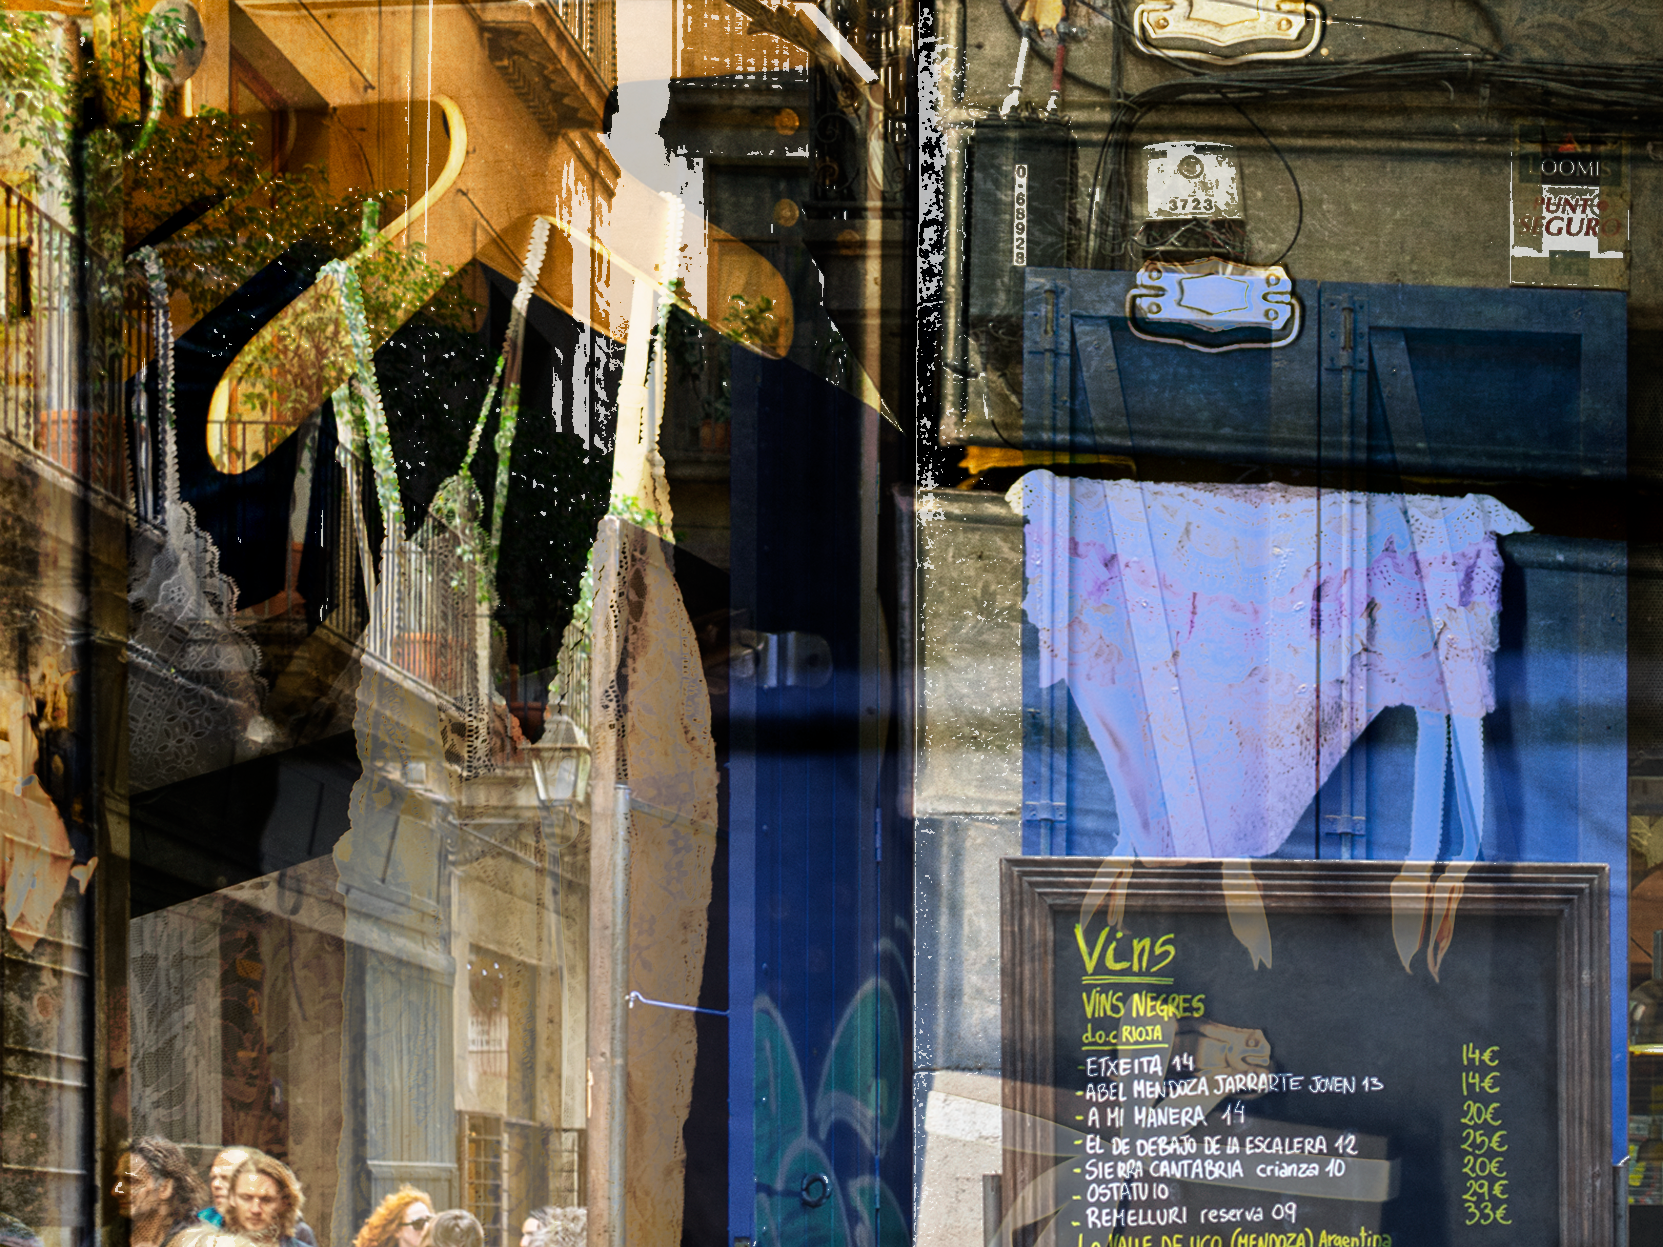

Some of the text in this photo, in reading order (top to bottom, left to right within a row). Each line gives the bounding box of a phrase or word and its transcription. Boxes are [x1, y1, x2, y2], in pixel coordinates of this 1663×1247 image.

[1528, 155, 1612, 177] LOOMIS
[1168, 198, 1214, 212] 3723
[1519, 216, 1622, 237] SEGURO
[1074, 922, 1176, 976] Vins
[1131, 993, 1205, 1021] NEGRES
[1122, 1025, 1162, 1042] RIOJA
[1086, 1052, 1193, 1077] ETXEITA 14
[1462, 1043, 1500, 1067] 14€
[1085, 1072, 1385, 1102] ABEL MENDOZA JARRARTE JOVEN 13
[1462, 1071, 1501, 1096] 14€
[1088, 1100, 1245, 1127] A MI MANERA 14
[1461, 1100, 1502, 1126] 20€
[1085, 1134, 1358, 1156] EL DE DEBAJO DE LA ESCALERA 12
[1461, 1128, 1508, 1154] 25€
[1085, 1158, 1345, 1180] SIERRA CANTABRIA crianza 10
[1462, 1155, 1507, 1178] 20€
[1087, 1182, 1148, 1202] OSTATU
[1086, 1202, 1297, 1228] REMELLURI reserva 09
[1465, 1202, 1512, 1225] 33€
